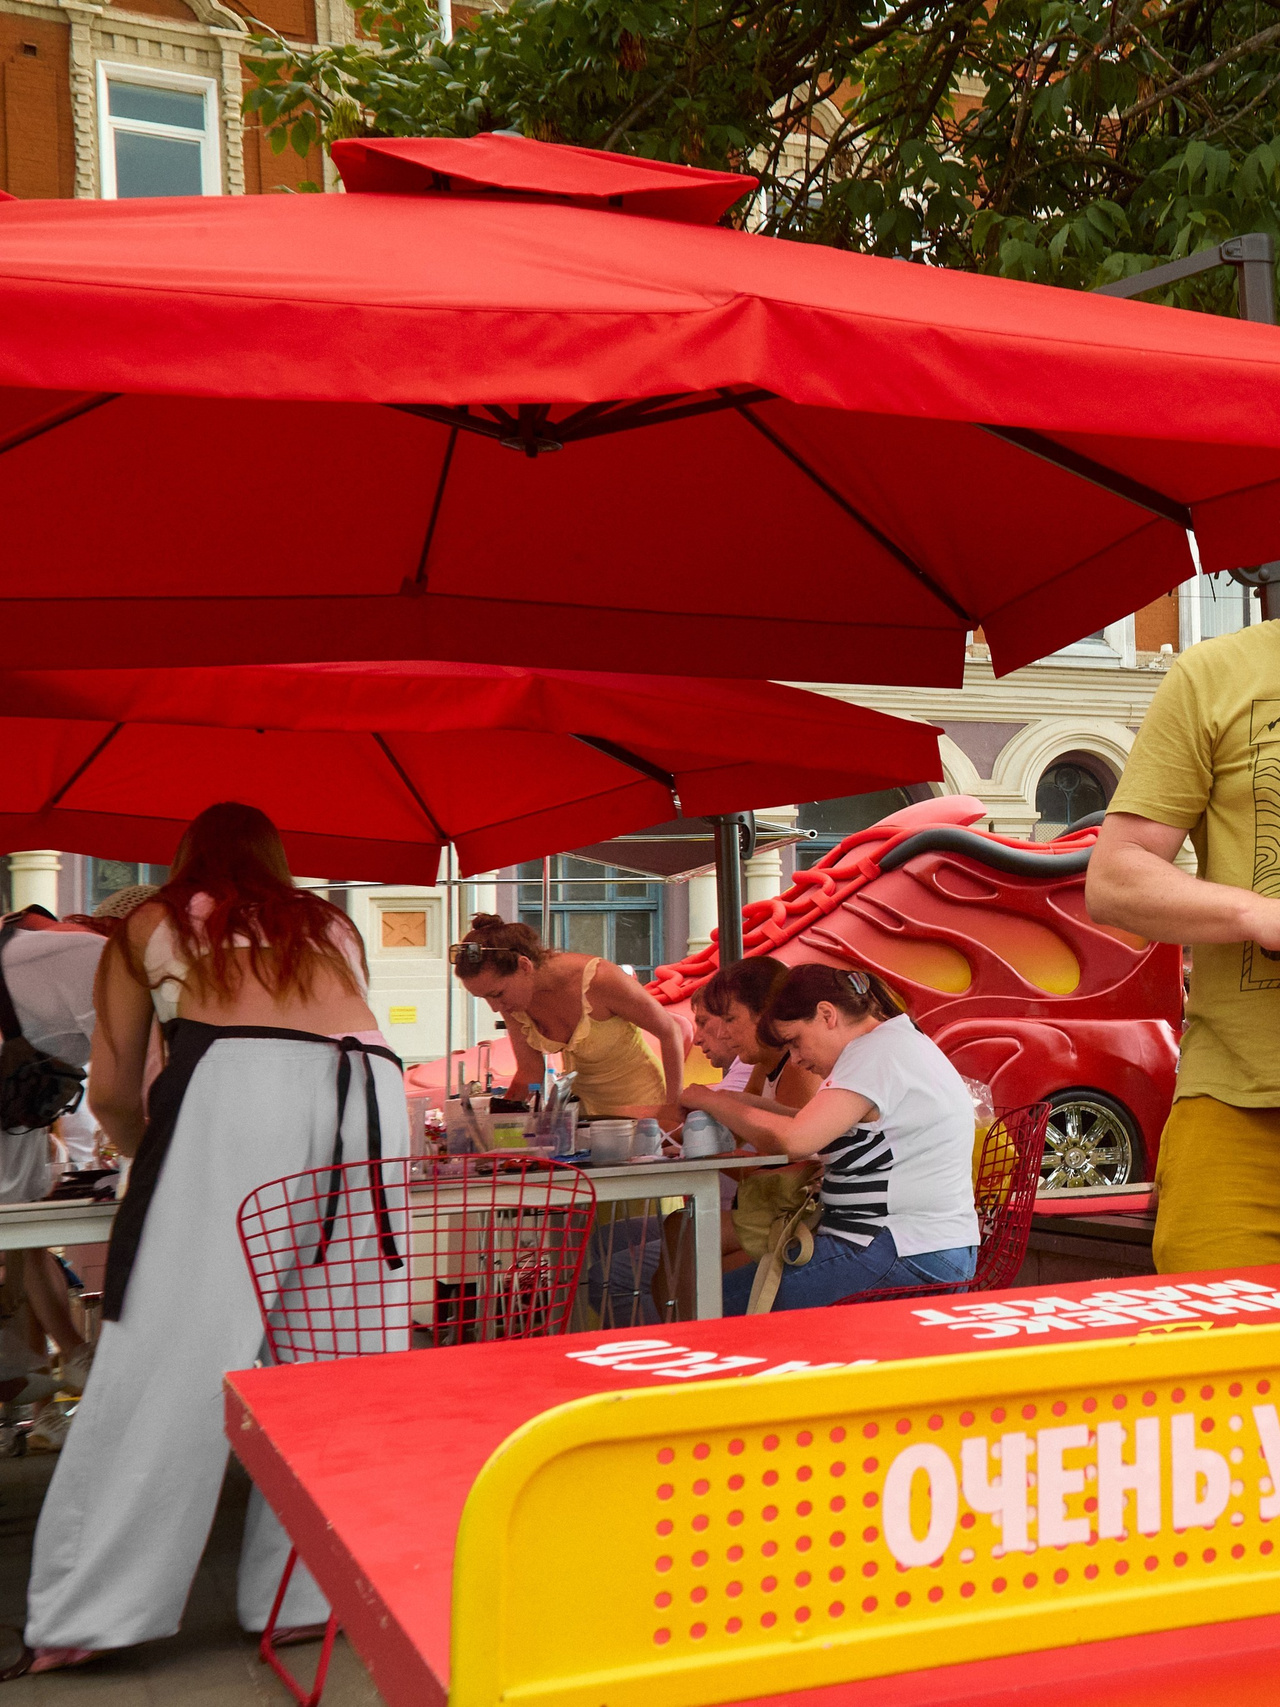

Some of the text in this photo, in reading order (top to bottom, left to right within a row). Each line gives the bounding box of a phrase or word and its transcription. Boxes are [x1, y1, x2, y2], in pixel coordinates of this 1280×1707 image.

[910, 1279, 1277, 1327] МАРКЕТ
[565, 1339, 768, 1378] ЕСТЬ
[881, 1412, 1233, 1568] ОЧЕНЬ
